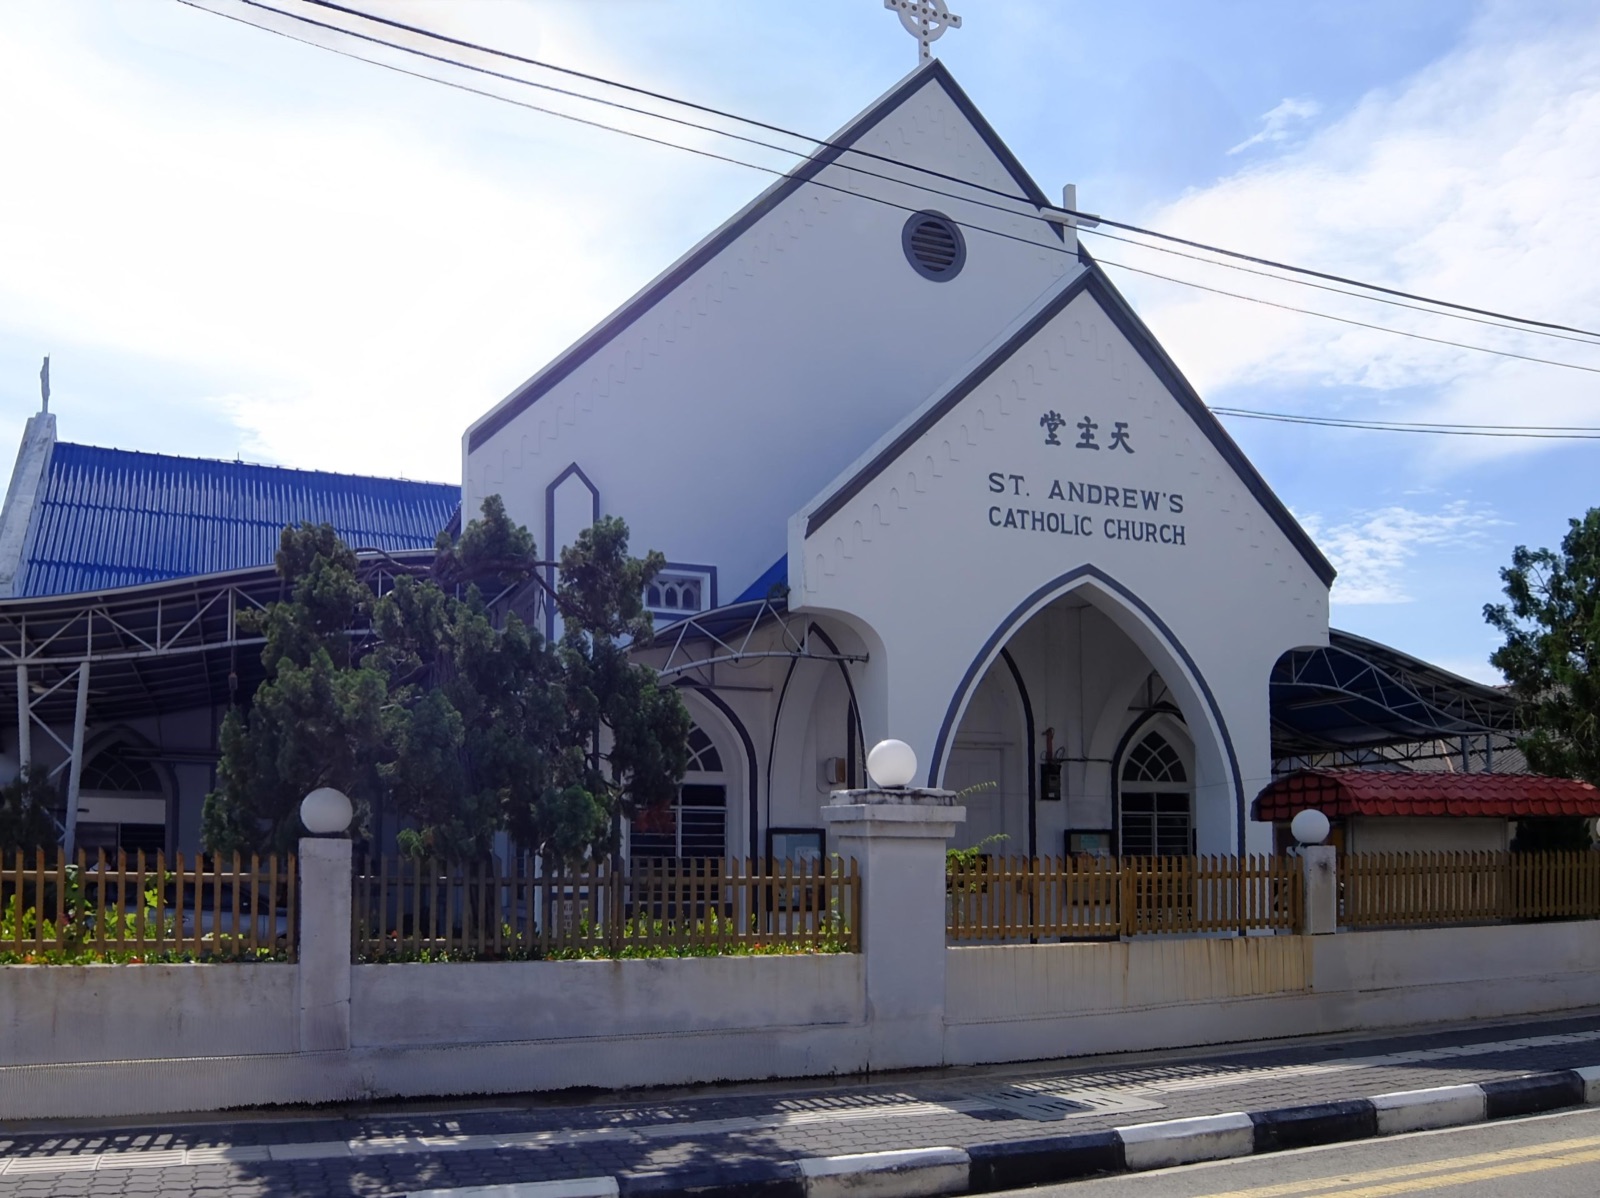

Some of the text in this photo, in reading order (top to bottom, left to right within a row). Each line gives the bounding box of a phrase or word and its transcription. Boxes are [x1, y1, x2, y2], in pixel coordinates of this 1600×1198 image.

[988, 472, 1184, 514] ST. ANDREW'S
[988, 506, 1186, 545] CATHOLIC CHURCH
